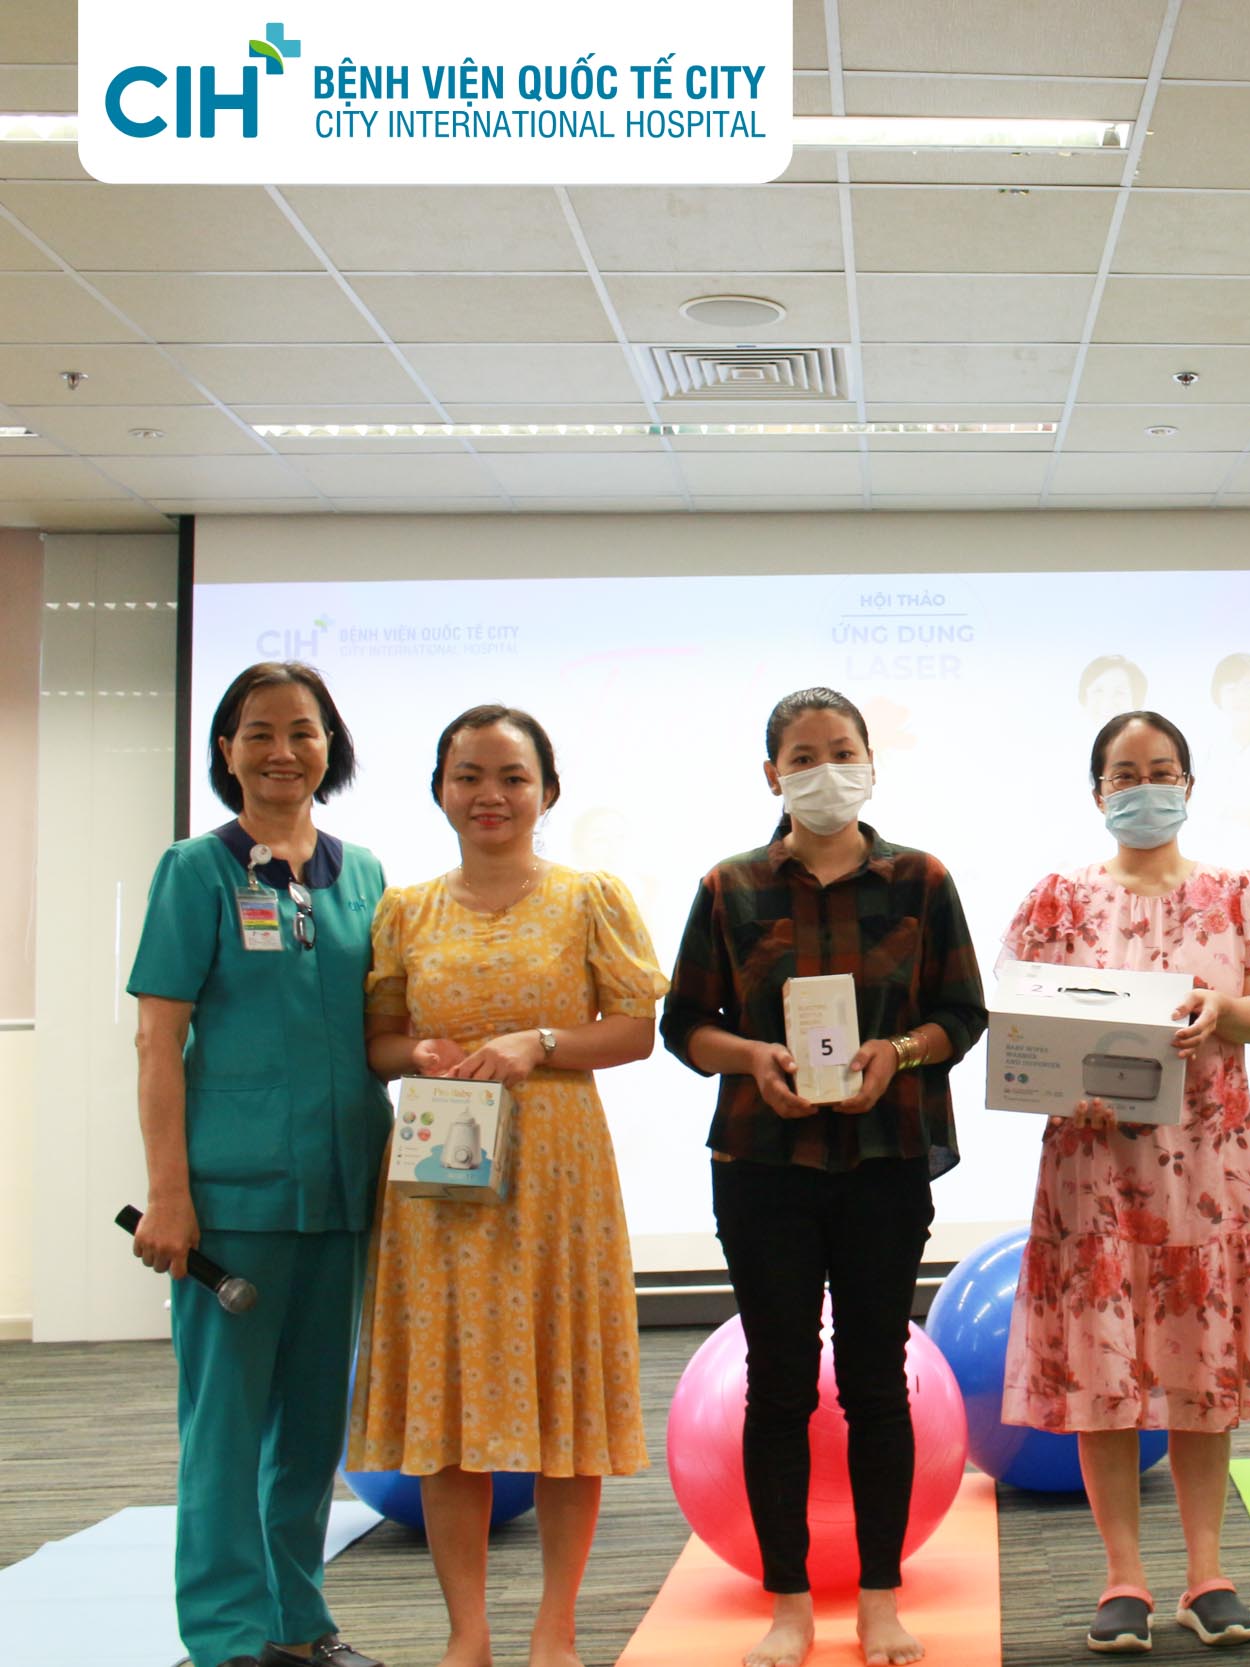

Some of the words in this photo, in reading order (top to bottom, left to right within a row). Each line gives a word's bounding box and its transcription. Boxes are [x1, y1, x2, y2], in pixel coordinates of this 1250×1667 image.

[860, 591, 891, 609] HỘI
[896, 589, 946, 607] THẢO
[256, 629, 319, 658] CIH
[831, 622, 888, 645] ỨNG
[897, 624, 976, 648] DỤNG
[845, 655, 962, 680] LASER
[820, 1038, 834, 1056] 5
